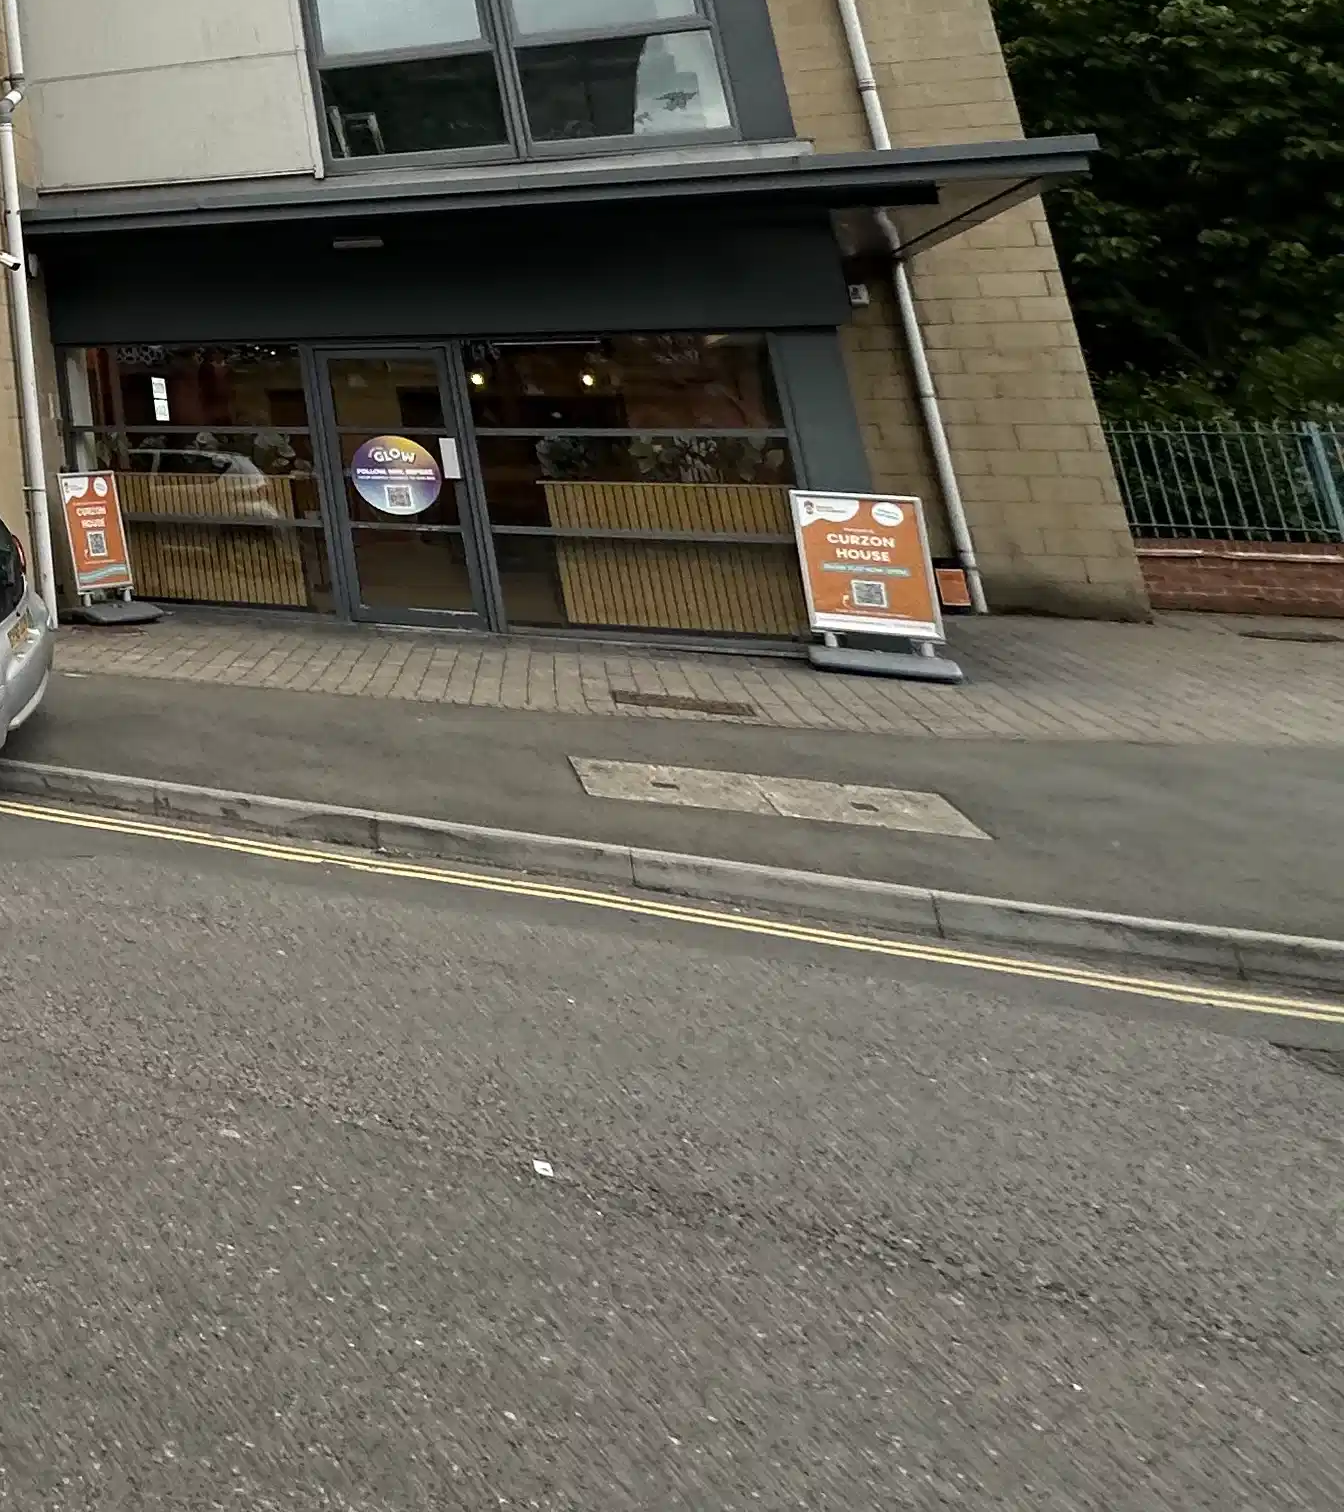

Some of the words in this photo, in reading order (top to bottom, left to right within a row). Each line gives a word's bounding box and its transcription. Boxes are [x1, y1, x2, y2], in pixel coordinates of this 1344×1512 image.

[373, 448, 416, 464] GLOW
[826, 533, 896, 548] CURZON
[835, 548, 891, 563] HOUSE
